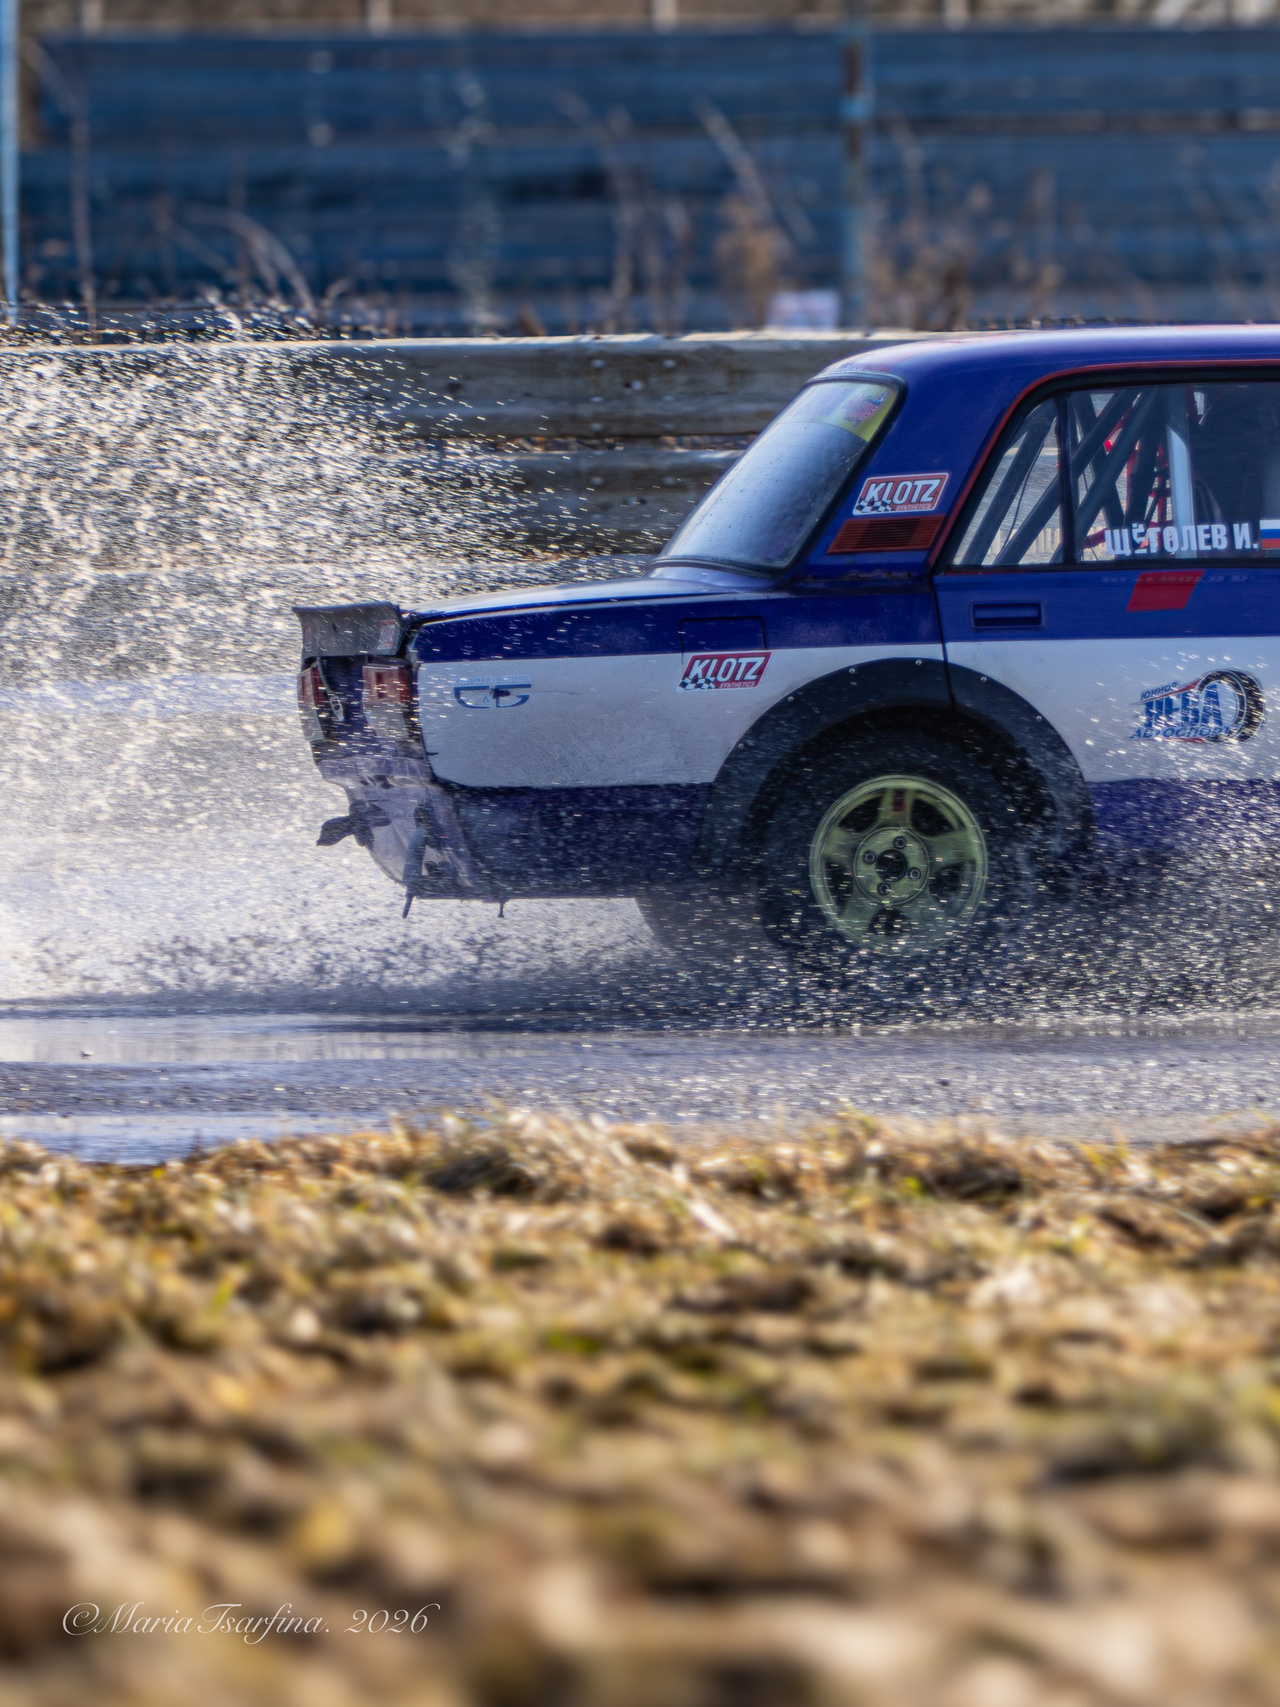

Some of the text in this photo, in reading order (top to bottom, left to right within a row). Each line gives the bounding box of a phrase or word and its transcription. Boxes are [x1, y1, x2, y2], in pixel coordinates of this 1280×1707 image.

[865, 479, 941, 505] KLOTZ
[895, 503, 932, 511] SYNTHETICS
[1233, 522, 1258, 549] И.
[688, 656, 766, 682] KLOTZ
